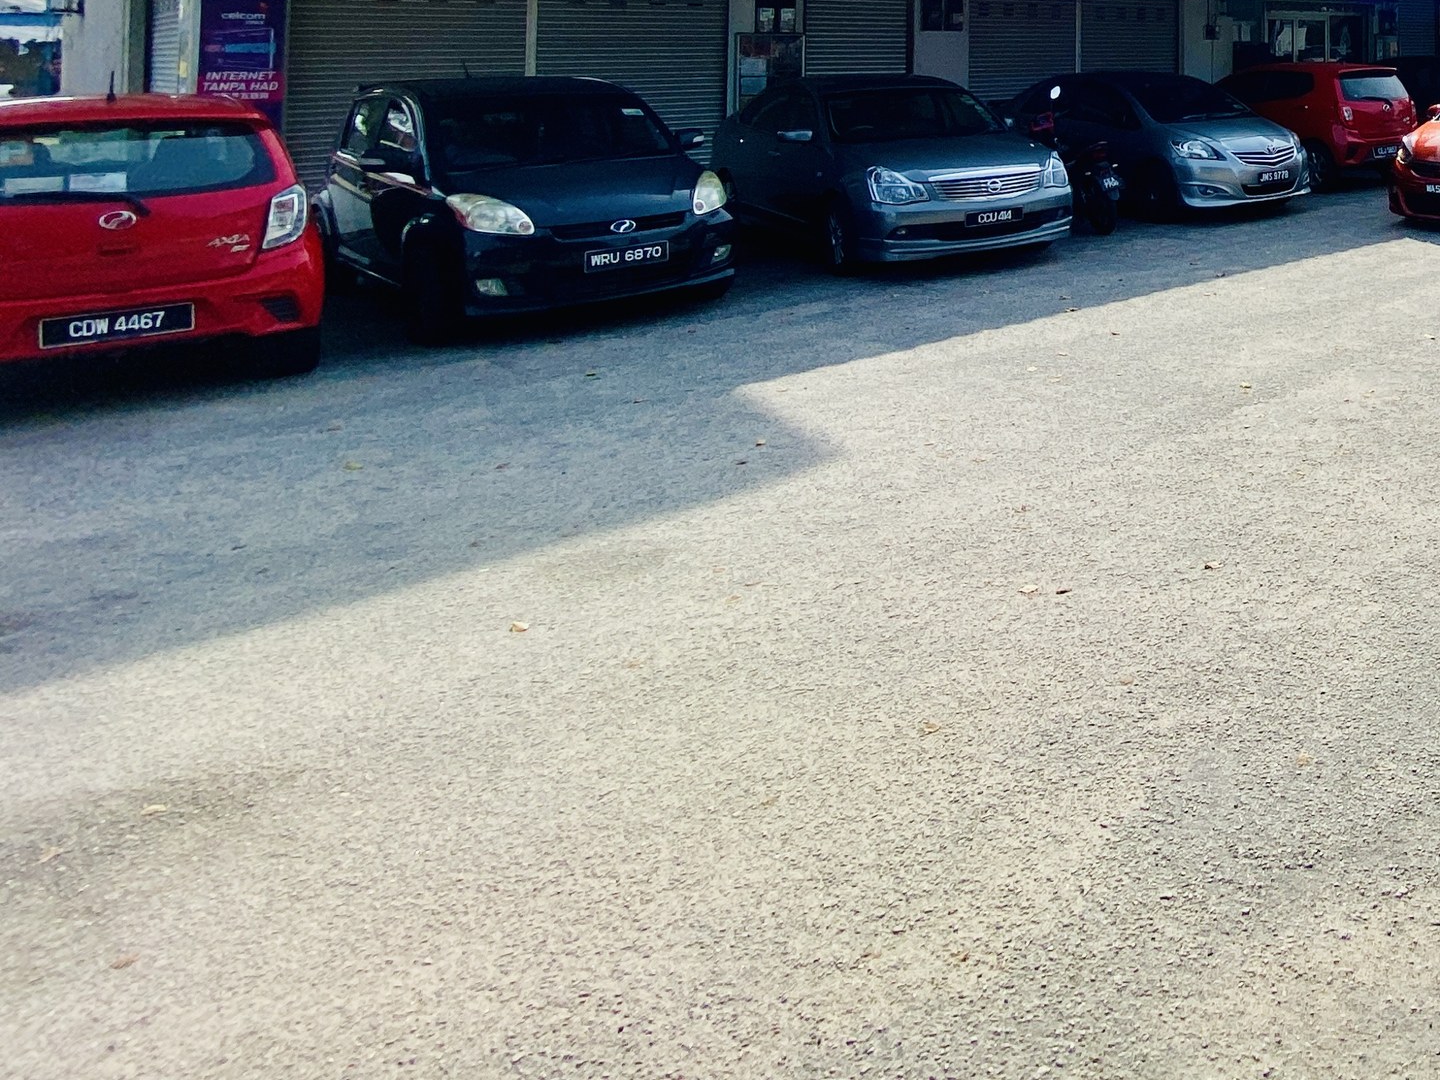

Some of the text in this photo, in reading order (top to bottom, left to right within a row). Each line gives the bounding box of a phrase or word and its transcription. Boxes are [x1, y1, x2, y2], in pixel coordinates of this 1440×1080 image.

[221, 12, 266, 20] celcom
[205, 71, 276, 80] INTERNET
[202, 81, 279, 91] TANPA HAD
[590, 246, 662, 268] WRU 6870
[69, 311, 166, 338] CDW 4467
